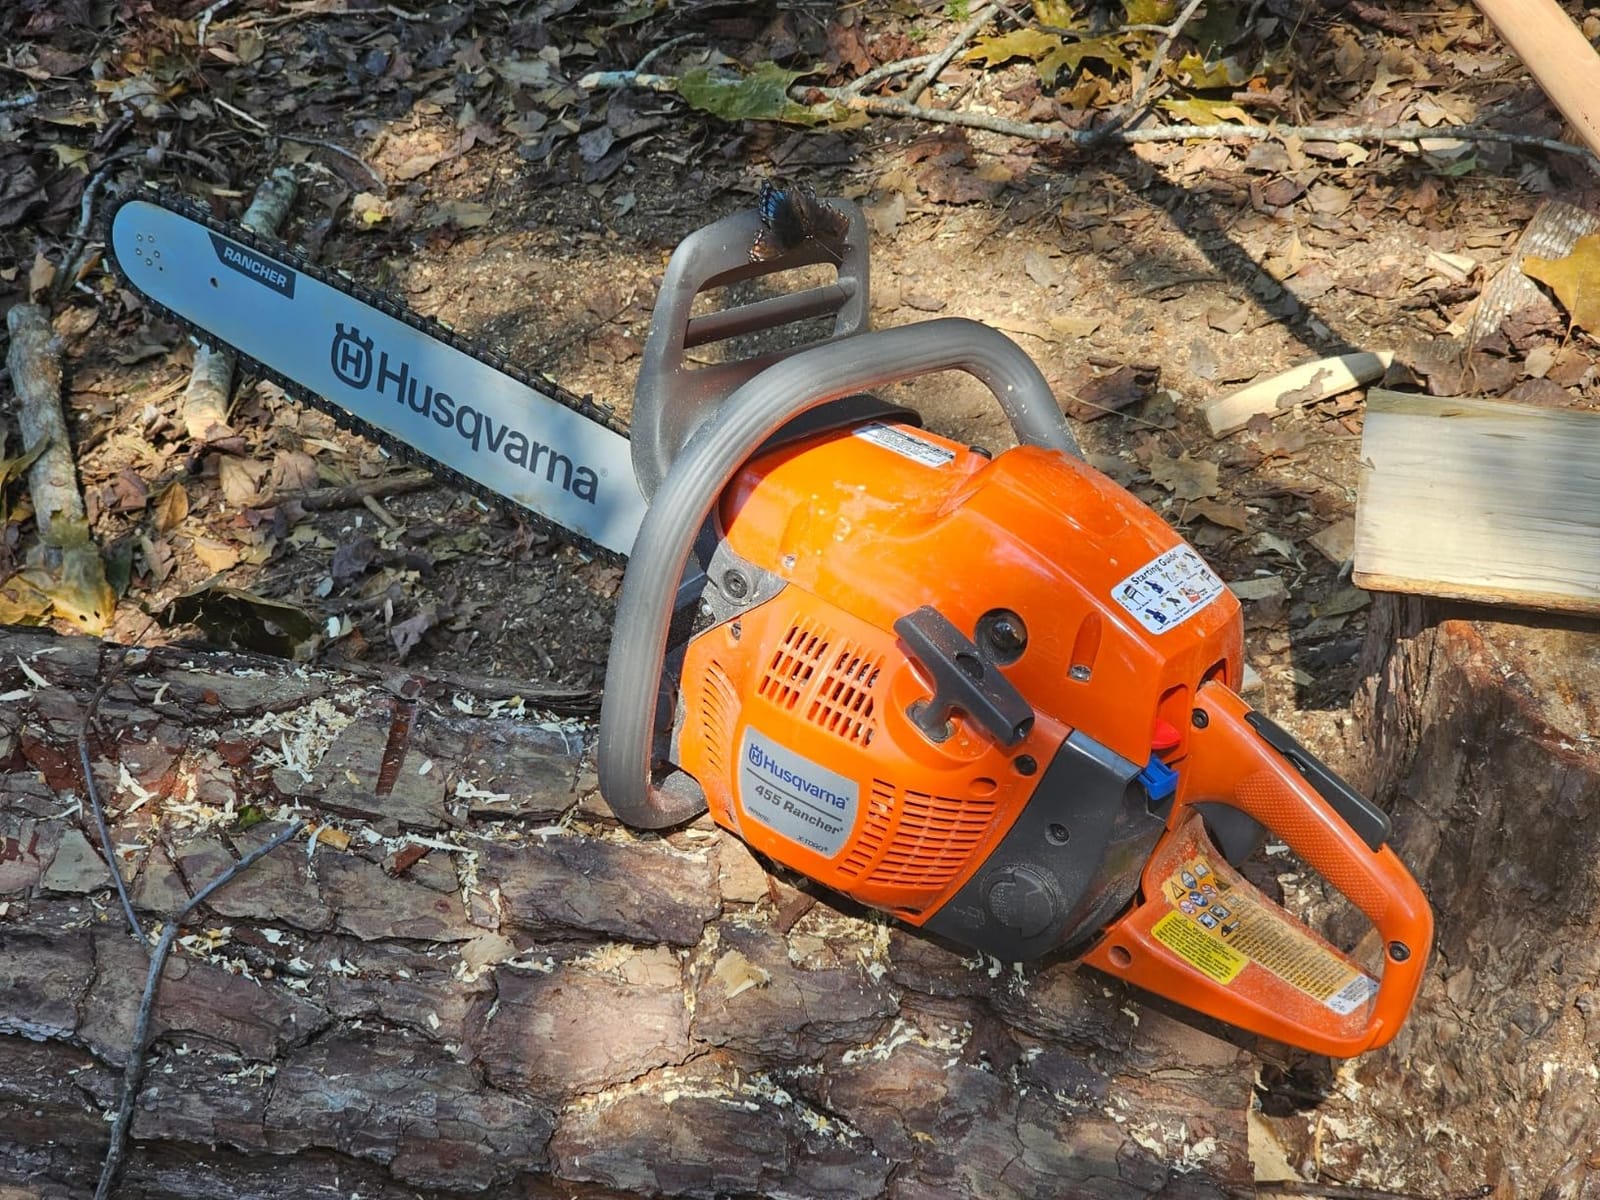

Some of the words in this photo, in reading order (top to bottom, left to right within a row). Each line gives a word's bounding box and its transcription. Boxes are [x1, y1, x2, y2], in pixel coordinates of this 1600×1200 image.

[223, 246, 287, 288] RANCHER
[377, 351, 599, 504] Husqvarna
[1130, 562, 1163, 585] Starting
[763, 755, 847, 810] Husqvarna
[755, 784, 782, 806] 455
[783, 800, 841, 835] Rancher
